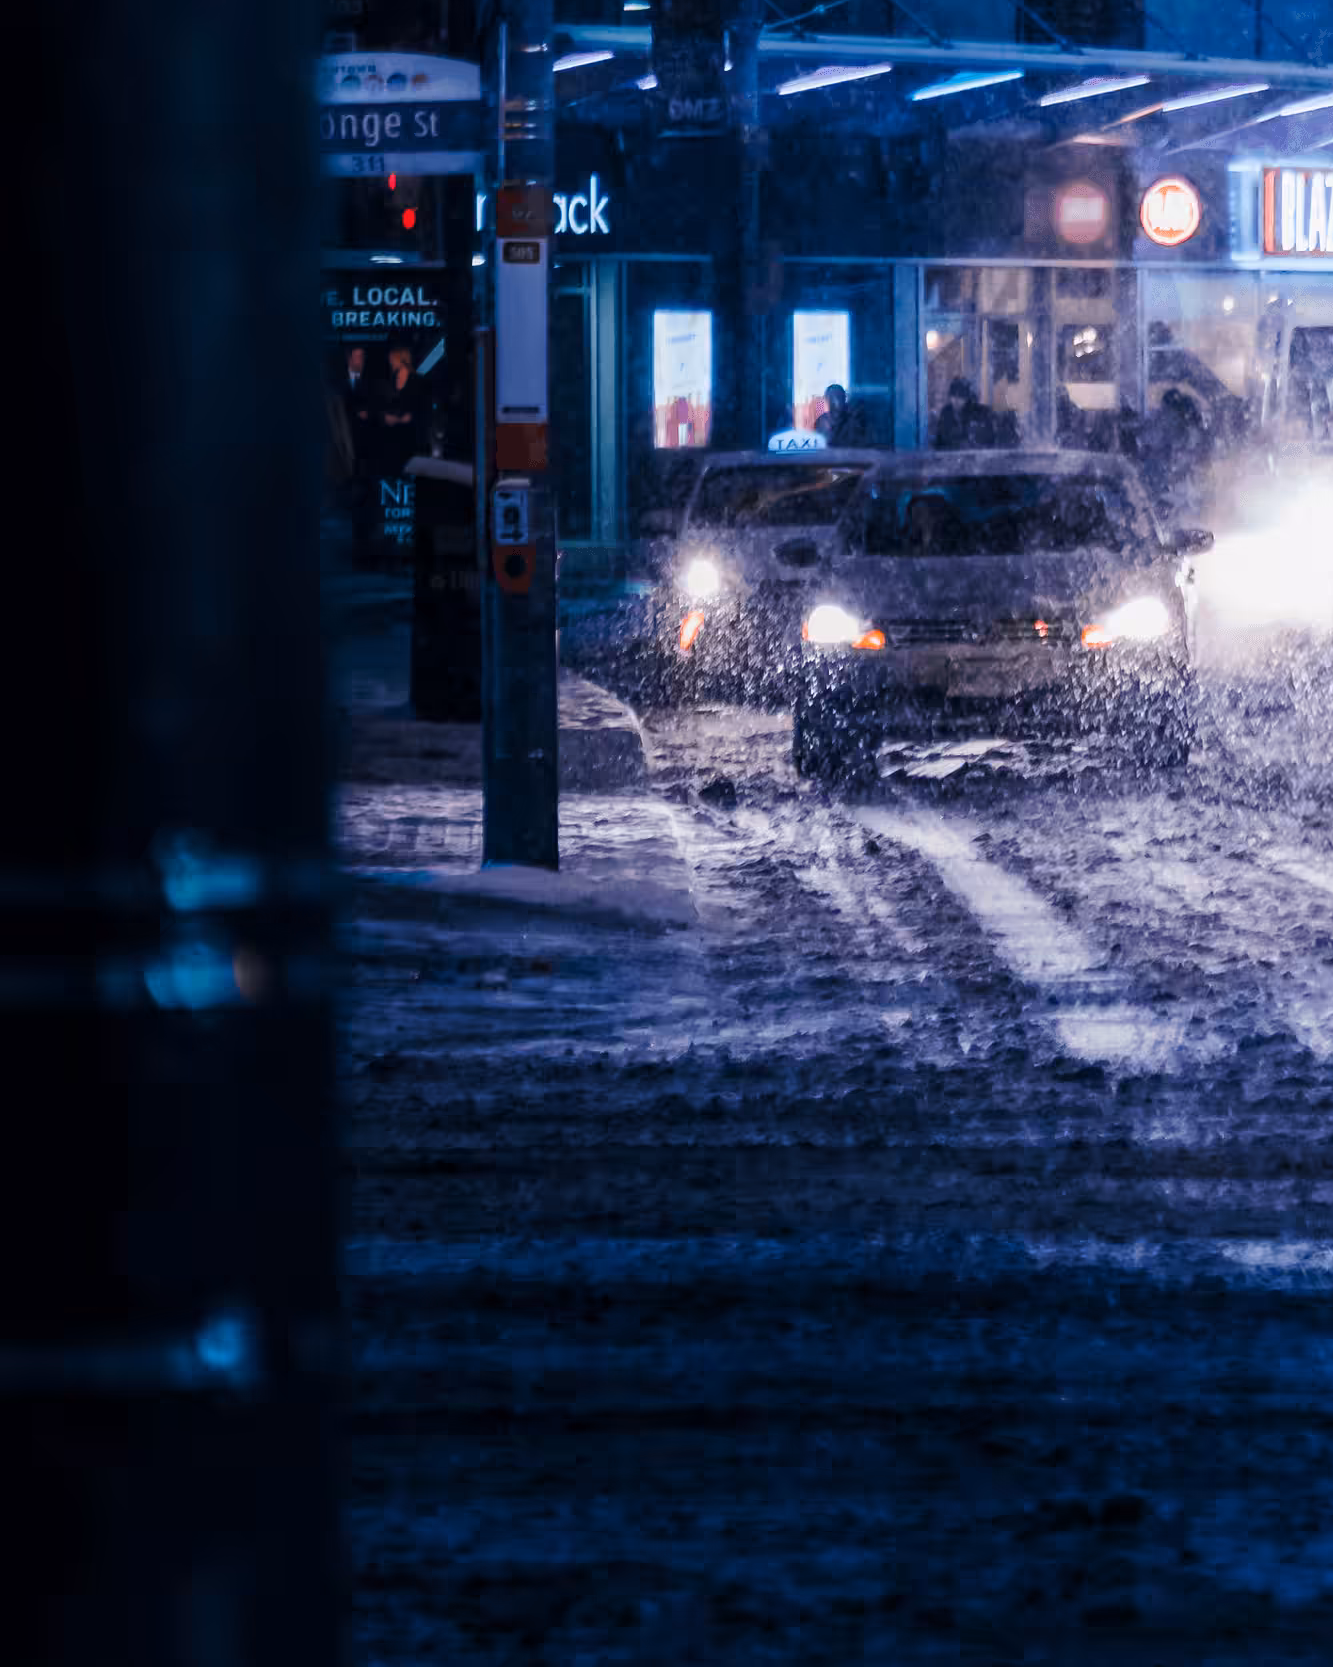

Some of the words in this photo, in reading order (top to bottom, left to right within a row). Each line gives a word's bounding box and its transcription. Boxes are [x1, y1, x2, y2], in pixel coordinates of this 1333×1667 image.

[413, 108, 441, 139] St
[353, 285, 439, 308] LOCAL.
[776, 438, 819, 451] TAXI
